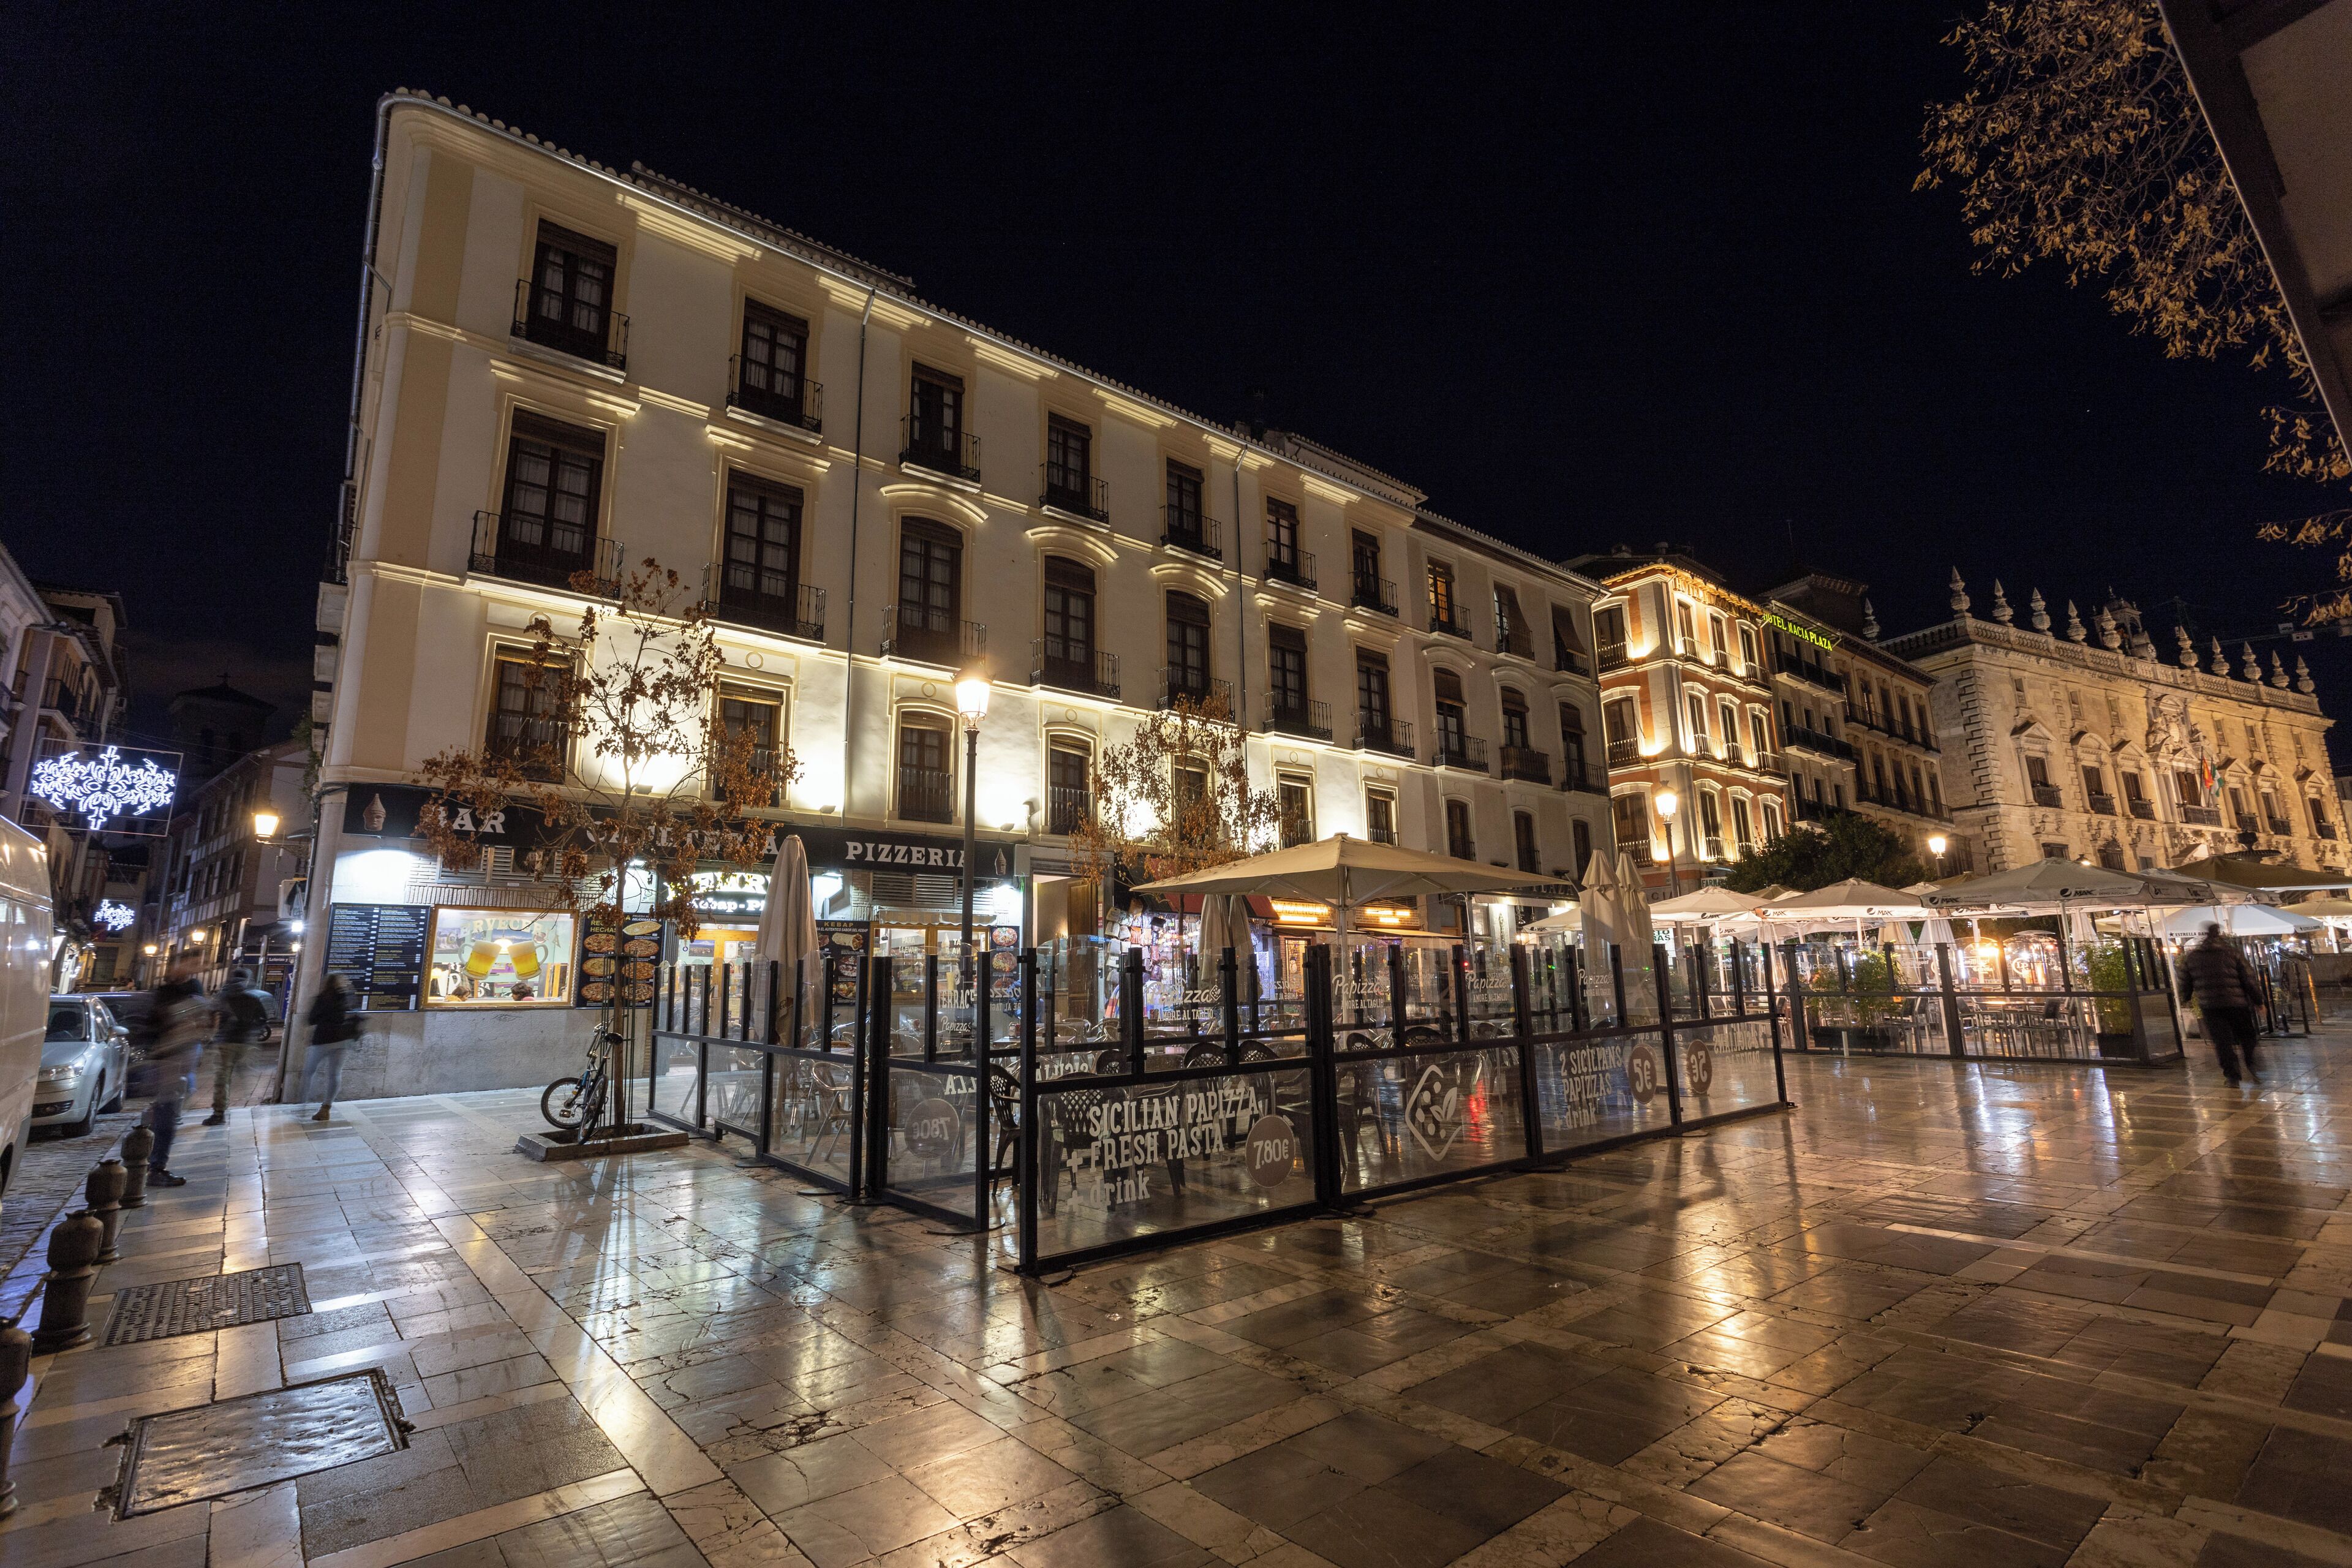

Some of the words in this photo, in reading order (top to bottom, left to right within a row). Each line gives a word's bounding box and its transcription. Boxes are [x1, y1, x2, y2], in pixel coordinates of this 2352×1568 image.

[1763, 612, 1787, 631] HOTEL
[1788, 620, 1809, 641] MACIA
[1809, 631, 1833, 651] PLAZA
[902, 936, 916, 944] PARA
[1332, 974, 1381, 998] Papizza
[1466, 972, 1507, 990] Papizza
[1578, 968, 1610, 985] Papizza
[1157, 1011, 1181, 1022] AMORE
[1183, 1011, 1191, 1021] AL
[1191, 1008, 1214, 1020] TAGLIO
[1341, 1000, 1359, 1009] AMORE
[1360, 1000, 1366, 1009] AL
[1366, 998, 1384, 1008] TAGLIO
[941, 1016, 968, 1033] Papizza
[1559, 1052, 1567, 1076] 2
[1570, 1046, 1623, 1074] SICILIANS
[1562, 1072, 1613, 1102] PAPIZZAS
[1633, 1058, 1653, 1093] 5€
[1088, 1095, 1179, 1138] SICILIAN
[1186, 1087, 1259, 1123] PAPIZZA
[1565, 1102, 1597, 1129] drink
[1090, 1131, 1159, 1173] FRESH
[1167, 1123, 1225, 1160] PASTA
[1090, 1170, 1151, 1207] drink
